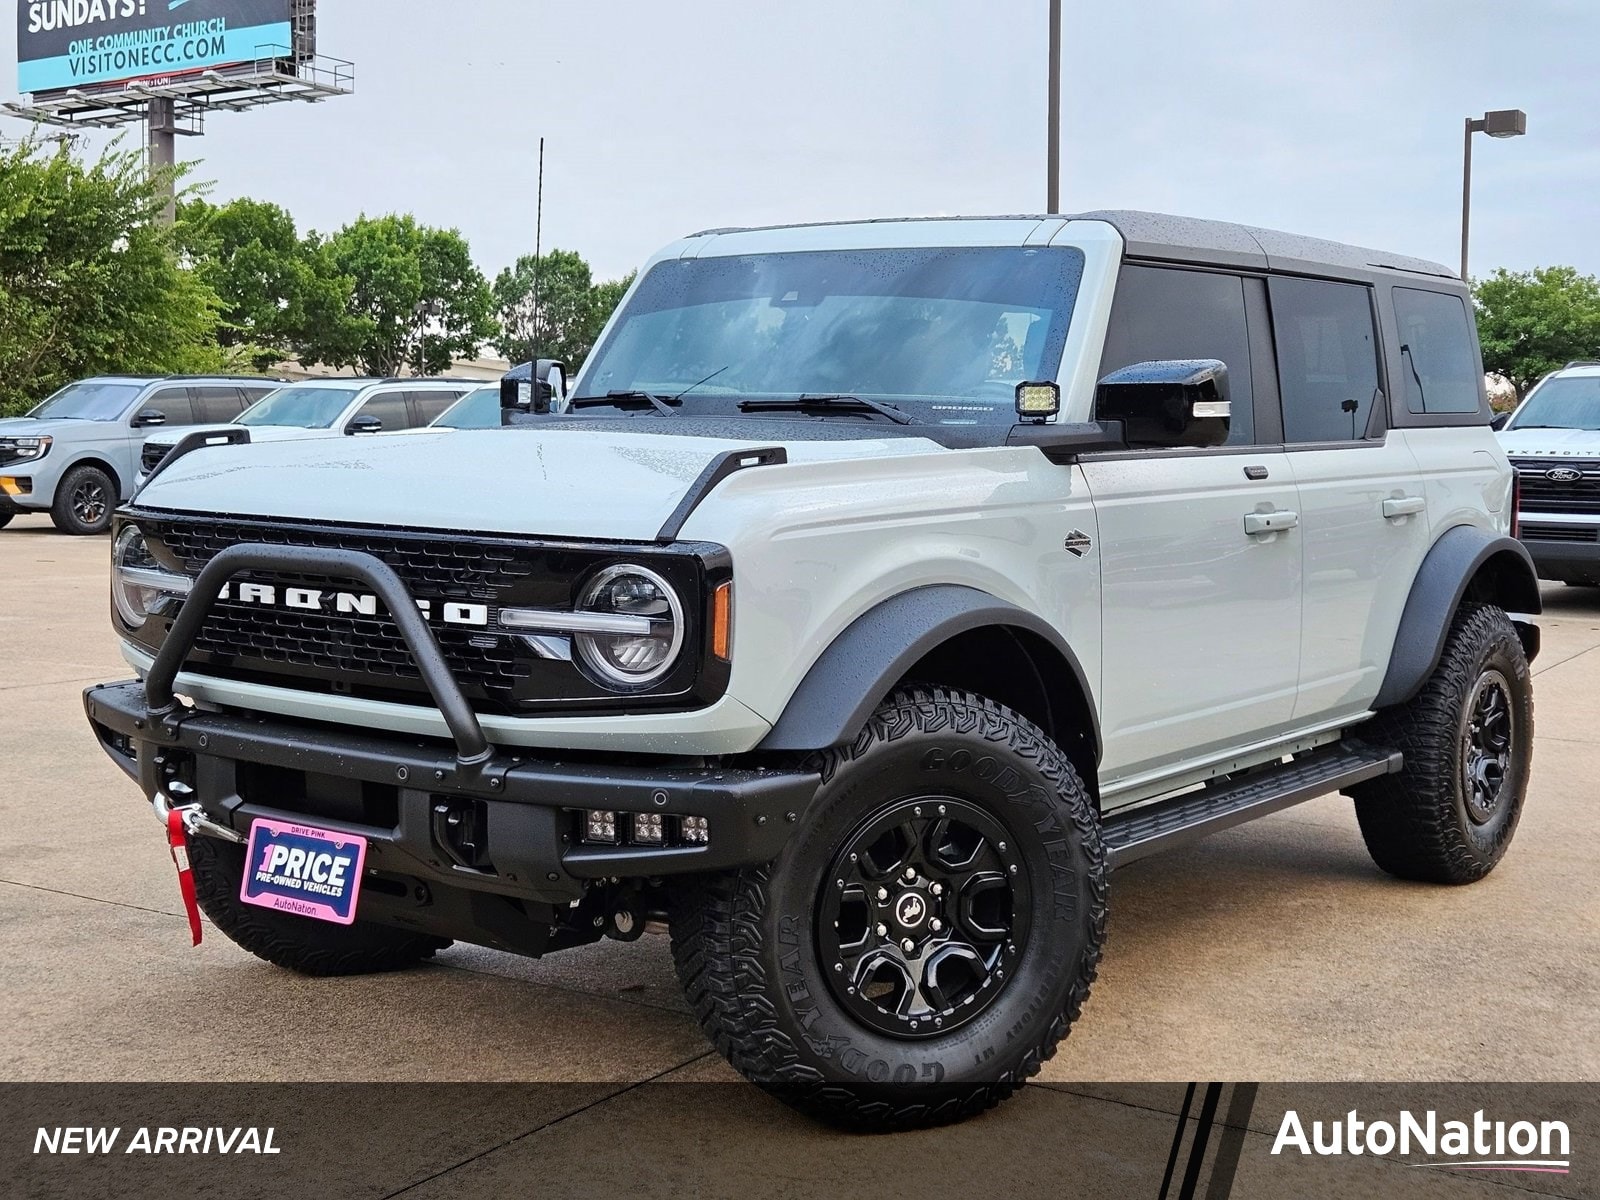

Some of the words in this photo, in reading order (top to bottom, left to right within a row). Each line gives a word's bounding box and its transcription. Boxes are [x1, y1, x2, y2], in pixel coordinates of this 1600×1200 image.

[68, 39, 93, 55] ONE
[96, 26, 171, 50] COMMUNITY
[173, 17, 226, 39] CHURCH
[68, 35, 226, 77] VISITONECC.COM
[1552, 470, 1575, 480] Ford
[217, 581, 488, 625] RONO
[291, 826, 310, 836] DRIVE
[310, 829, 326, 839] PINK
[919, 747, 1079, 924] GOODYEAR
[255, 871, 302, 889] PRE-OWNED
[303, 880, 343, 898] VEHICLES
[273, 898, 317, 915] AutoNation
